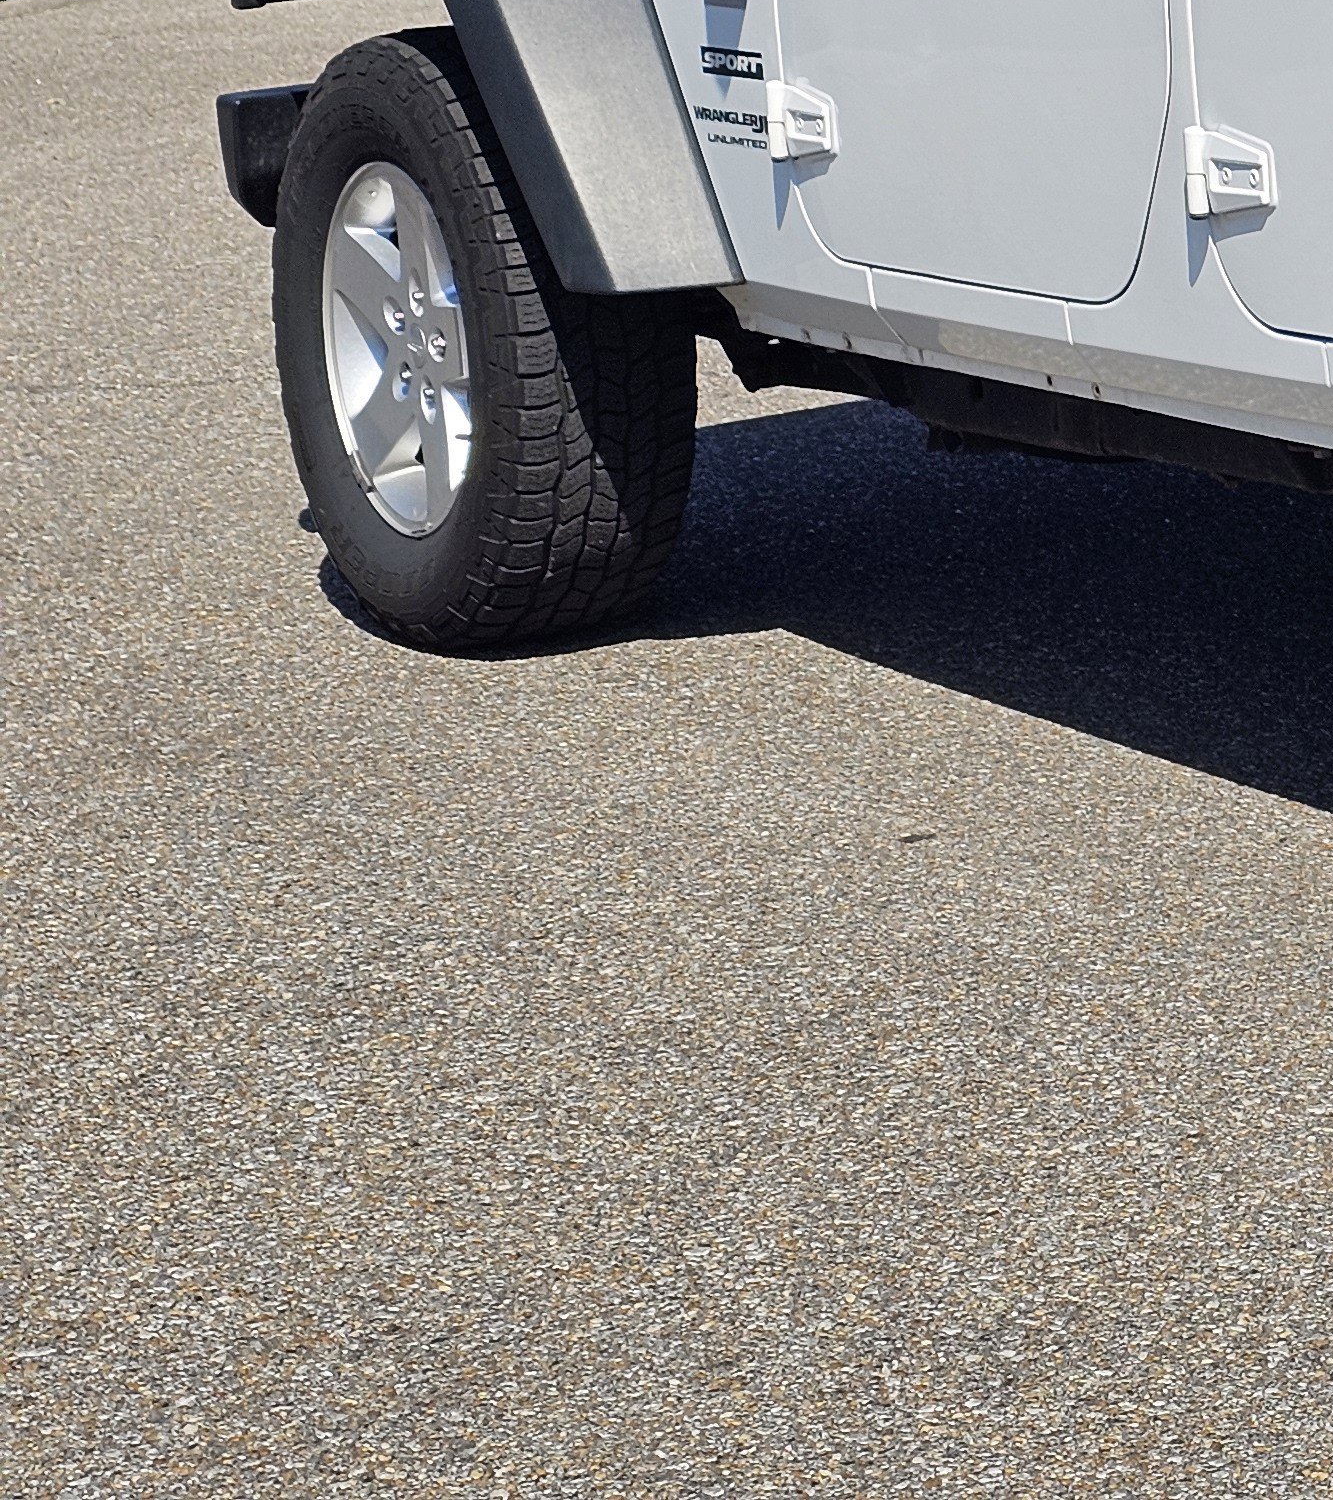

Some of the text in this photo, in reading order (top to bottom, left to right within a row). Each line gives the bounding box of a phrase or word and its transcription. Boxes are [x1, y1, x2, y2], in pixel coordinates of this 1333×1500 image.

[703, 51, 763, 73] SPORT
[693, 105, 758, 127] WRANGLER
[708, 133, 768, 150] UNLIMITED
